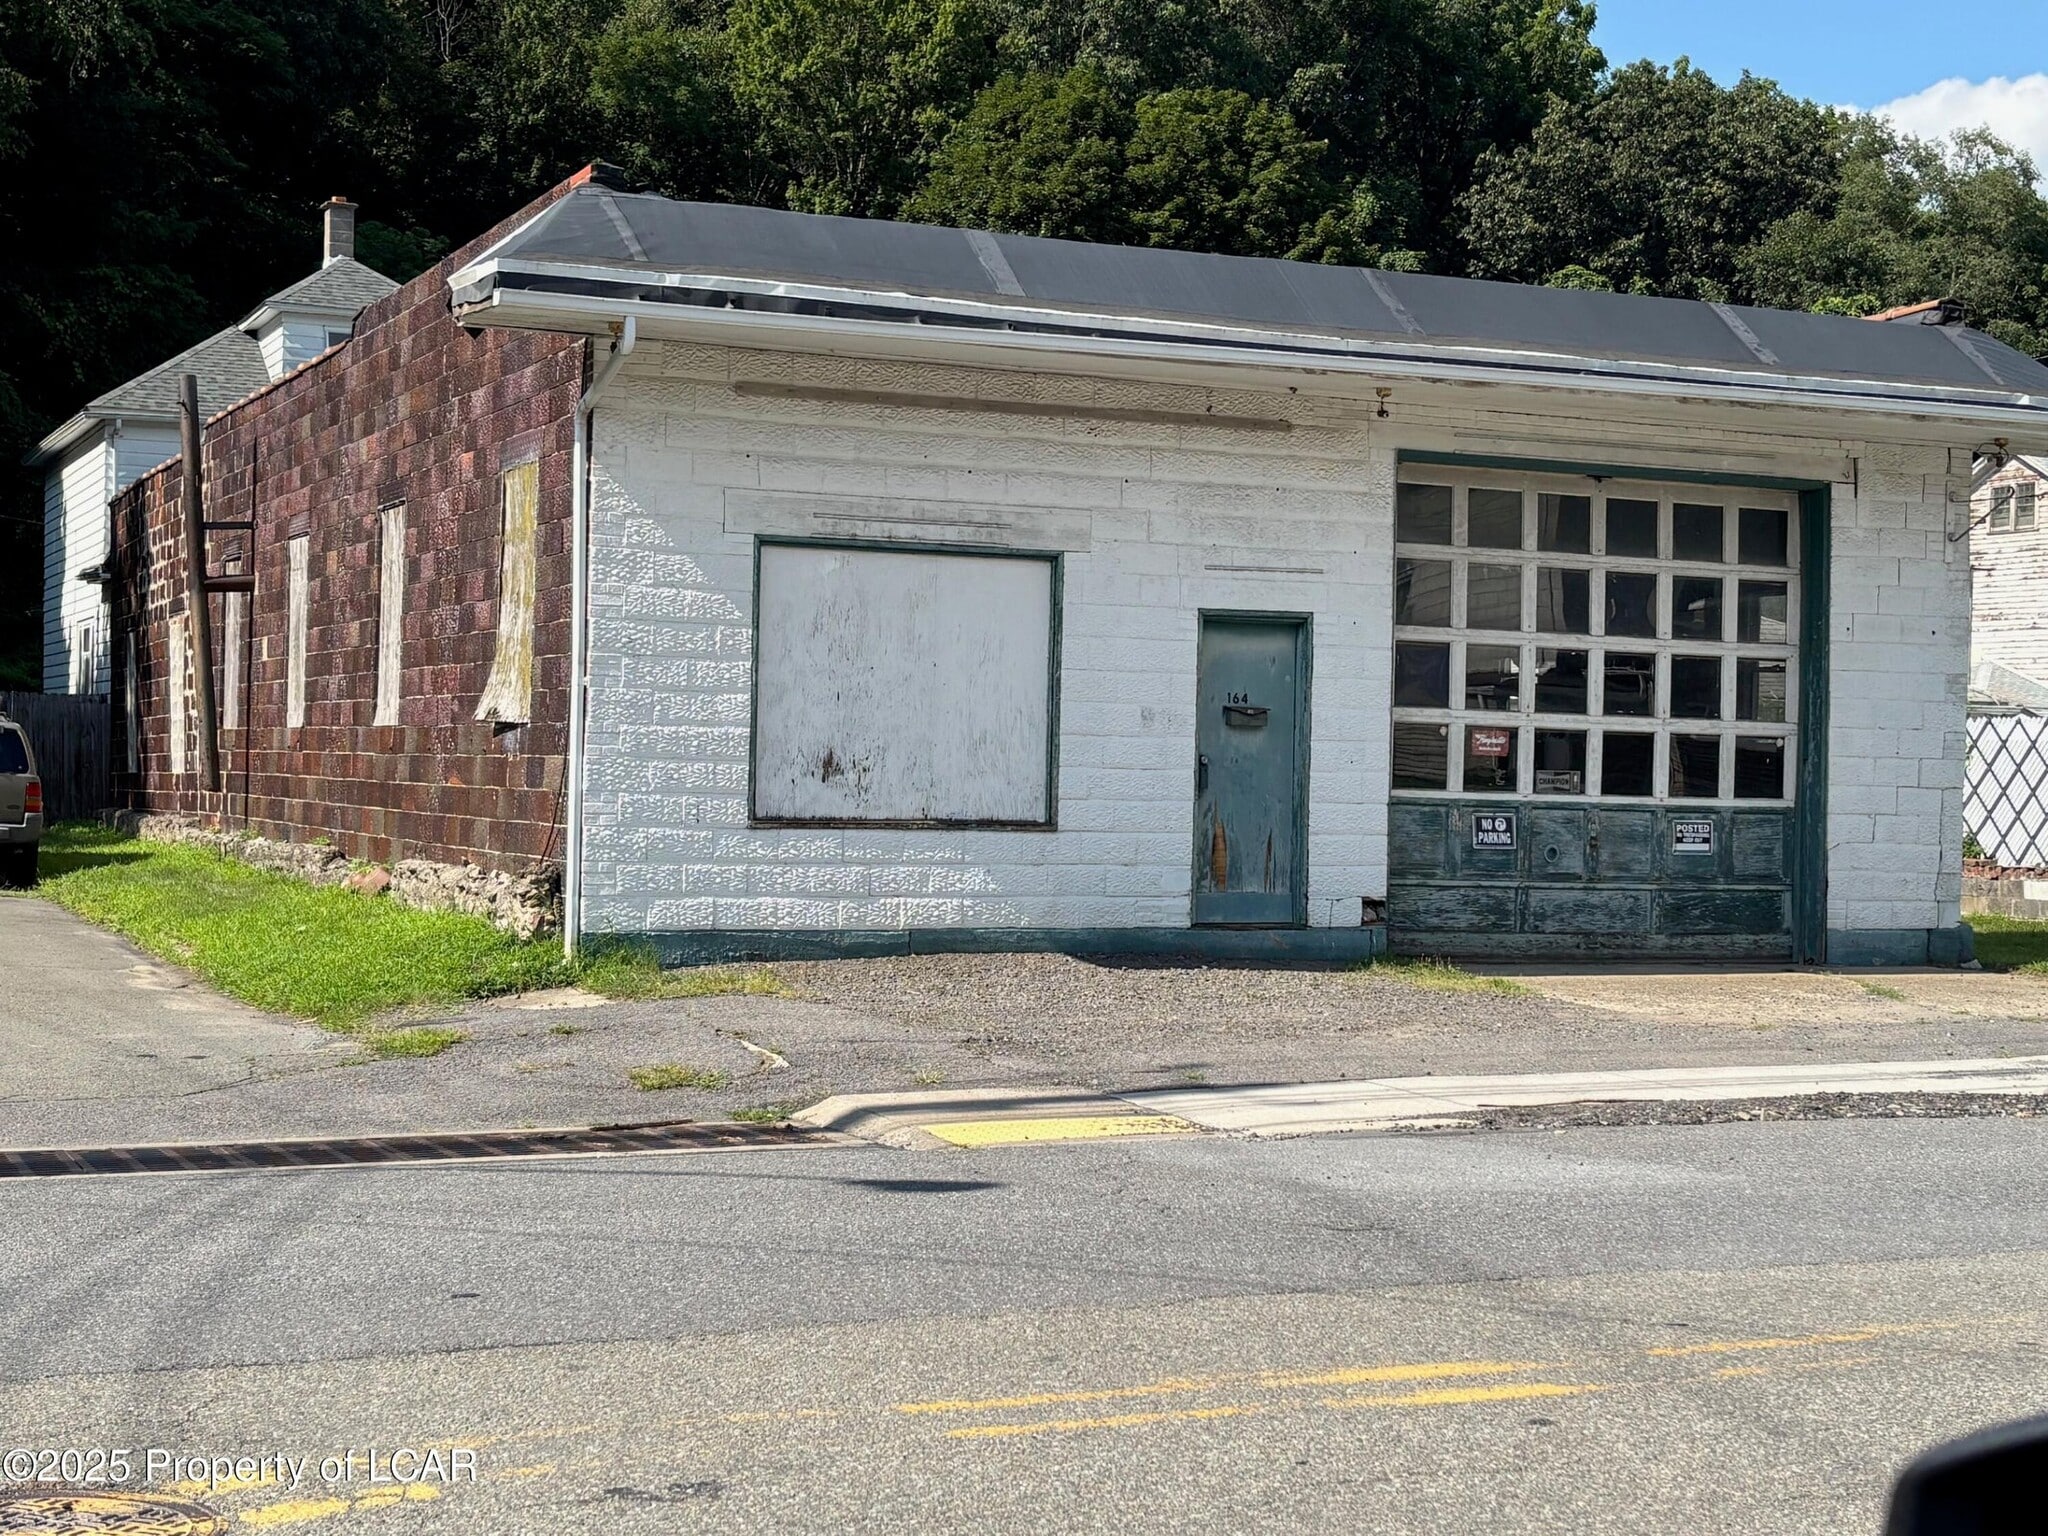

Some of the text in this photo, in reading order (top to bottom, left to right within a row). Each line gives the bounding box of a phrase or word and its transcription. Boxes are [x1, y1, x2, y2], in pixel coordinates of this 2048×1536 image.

[1227, 692, 1248, 704] 164
[1538, 777, 1569, 786] CHAMPION
[1481, 818, 1493, 831] NO
[1676, 824, 1710, 833] POSTED
[1478, 831, 1511, 844] PARKING
